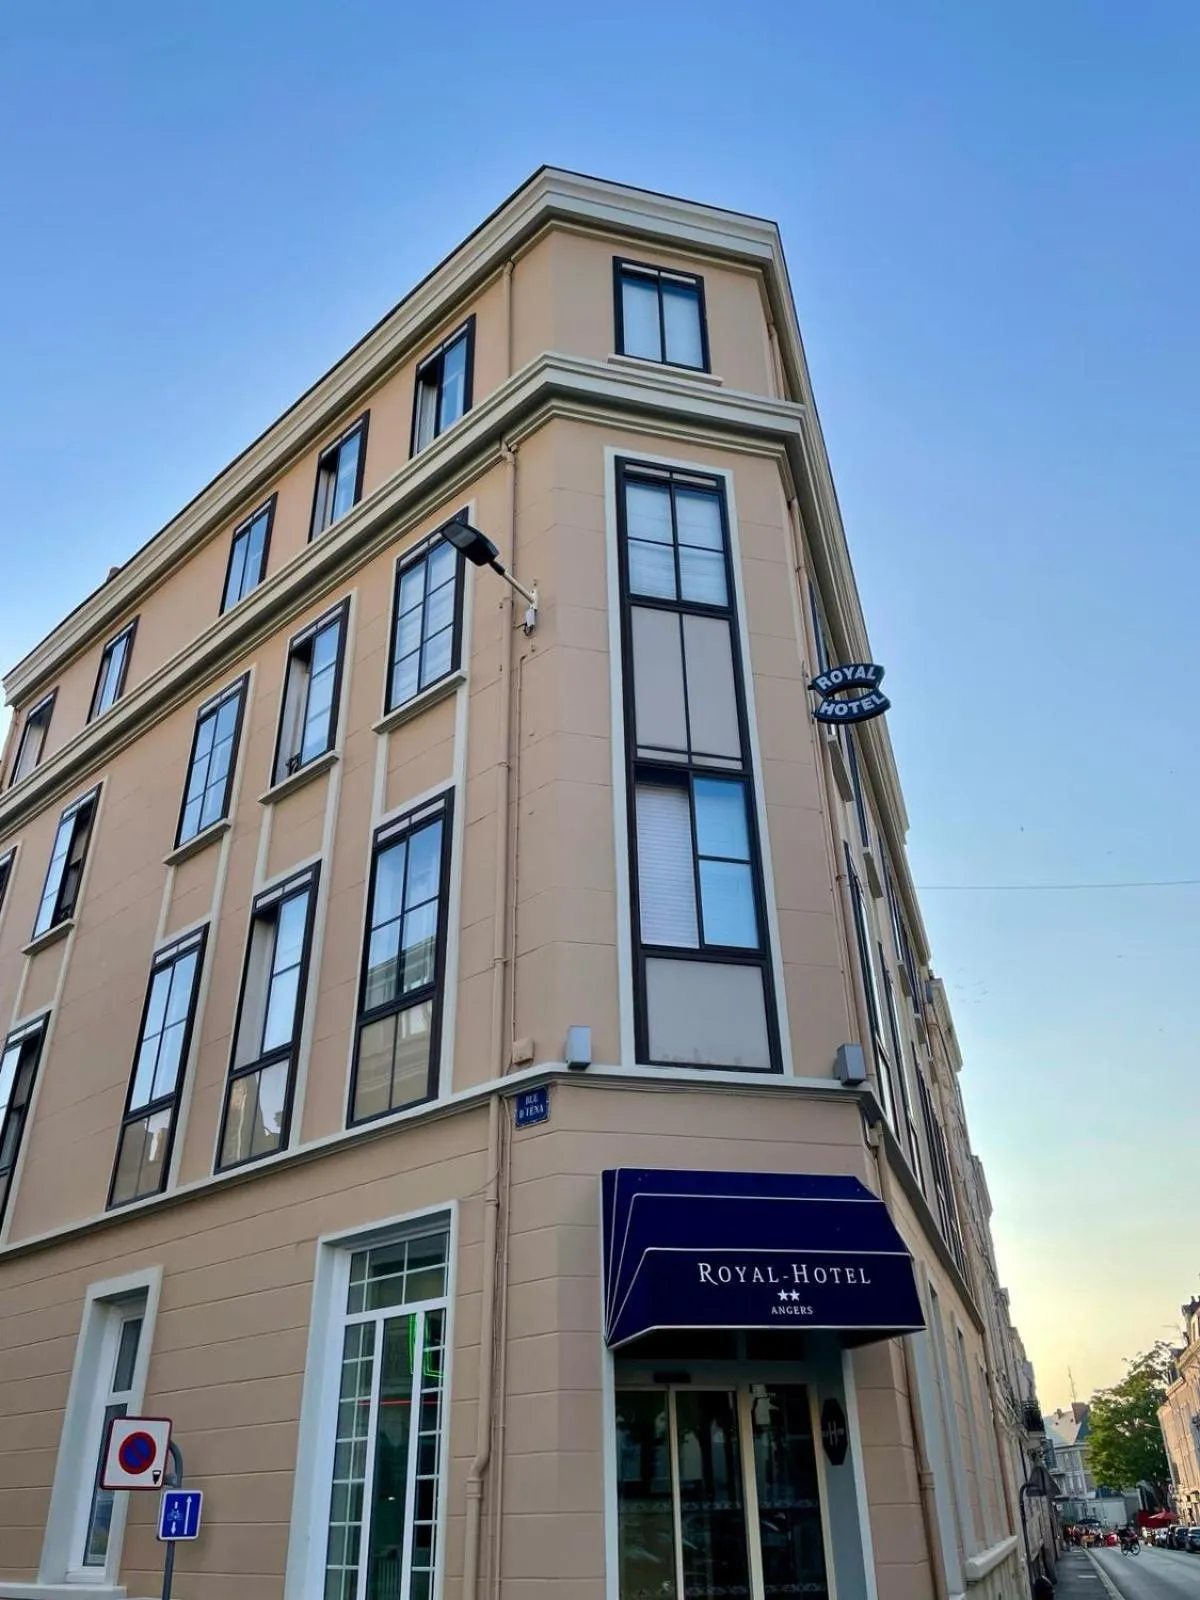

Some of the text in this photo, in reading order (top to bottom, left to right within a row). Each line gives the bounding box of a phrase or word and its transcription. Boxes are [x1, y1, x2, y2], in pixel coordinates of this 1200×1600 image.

[816, 666, 876, 690] ROYAL
[820, 694, 886, 716] HOTEL
[771, 1305, 814, 1316] ANGERS
